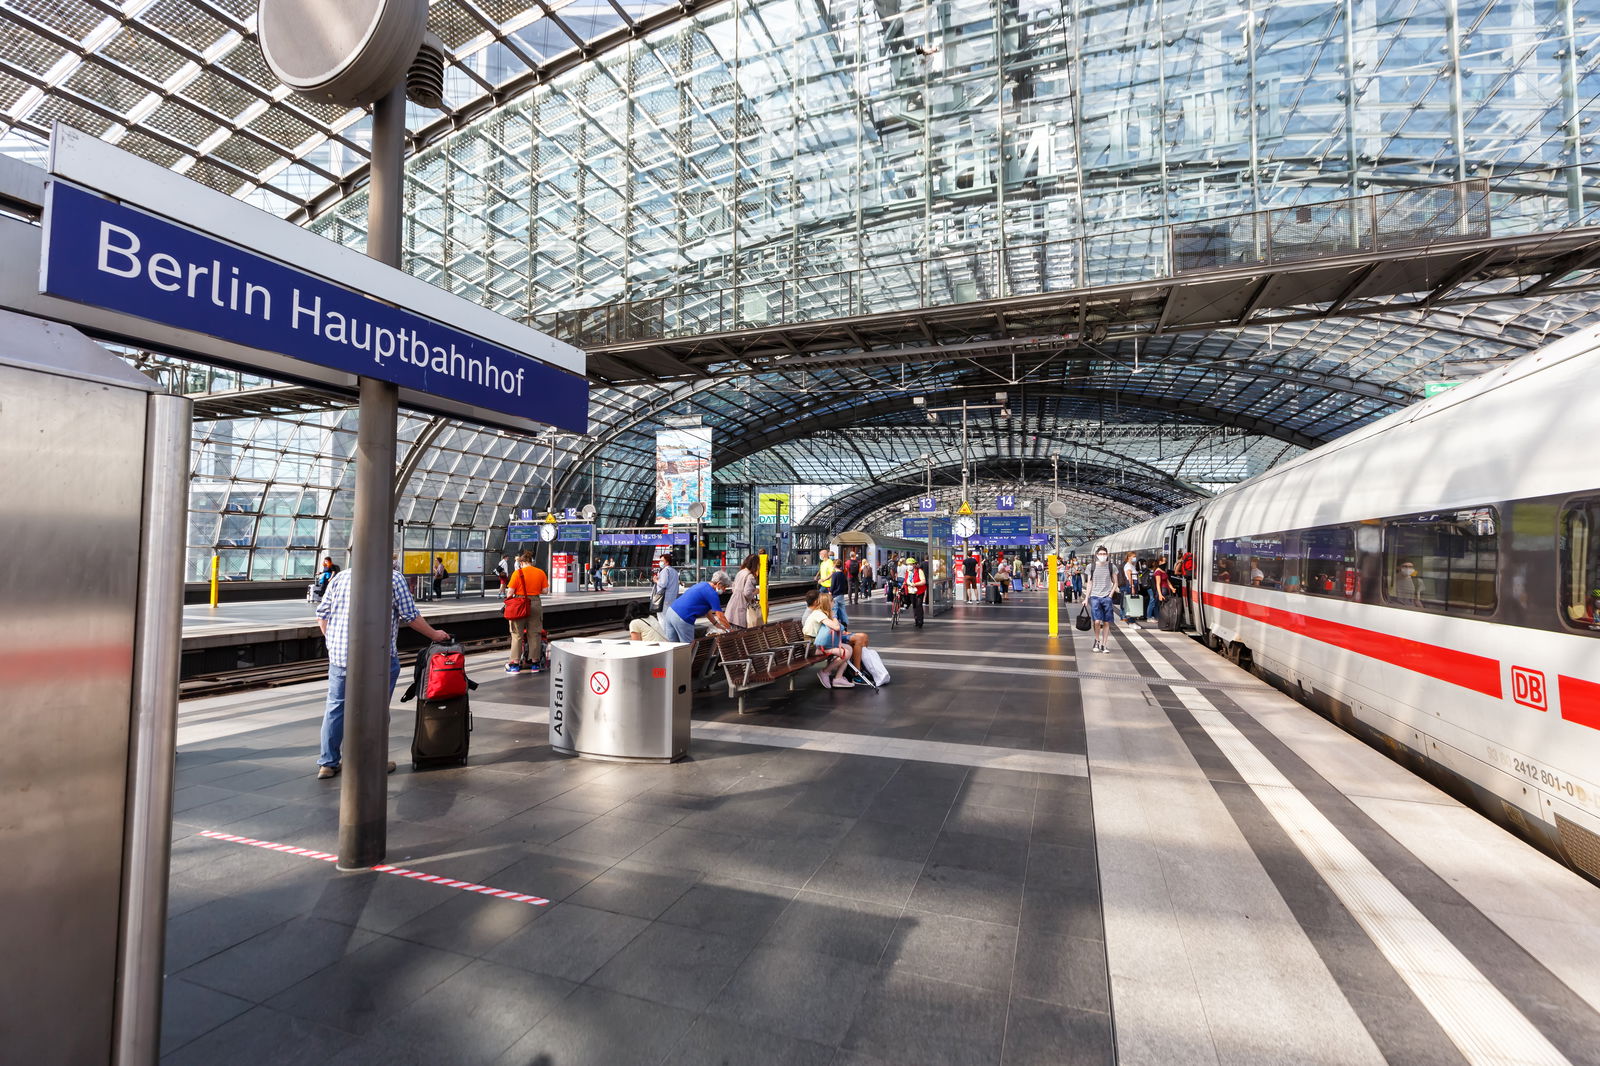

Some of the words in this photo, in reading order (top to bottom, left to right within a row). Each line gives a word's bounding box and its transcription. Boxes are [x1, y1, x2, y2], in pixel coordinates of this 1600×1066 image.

[97, 220, 271, 321] Berlin
[291, 287, 526, 397] Hauptbahnhof
[567, 508, 576, 517] 12
[920, 498, 932, 509] 13
[1001, 496, 1012, 507] 14
[522, 509, 529, 518] 11
[1514, 670, 1544, 705] DB
[553, 677, 564, 737] Abfall
[1513, 757, 1539, 781] 2412
[1540, 769, 1575, 797] 801-0
